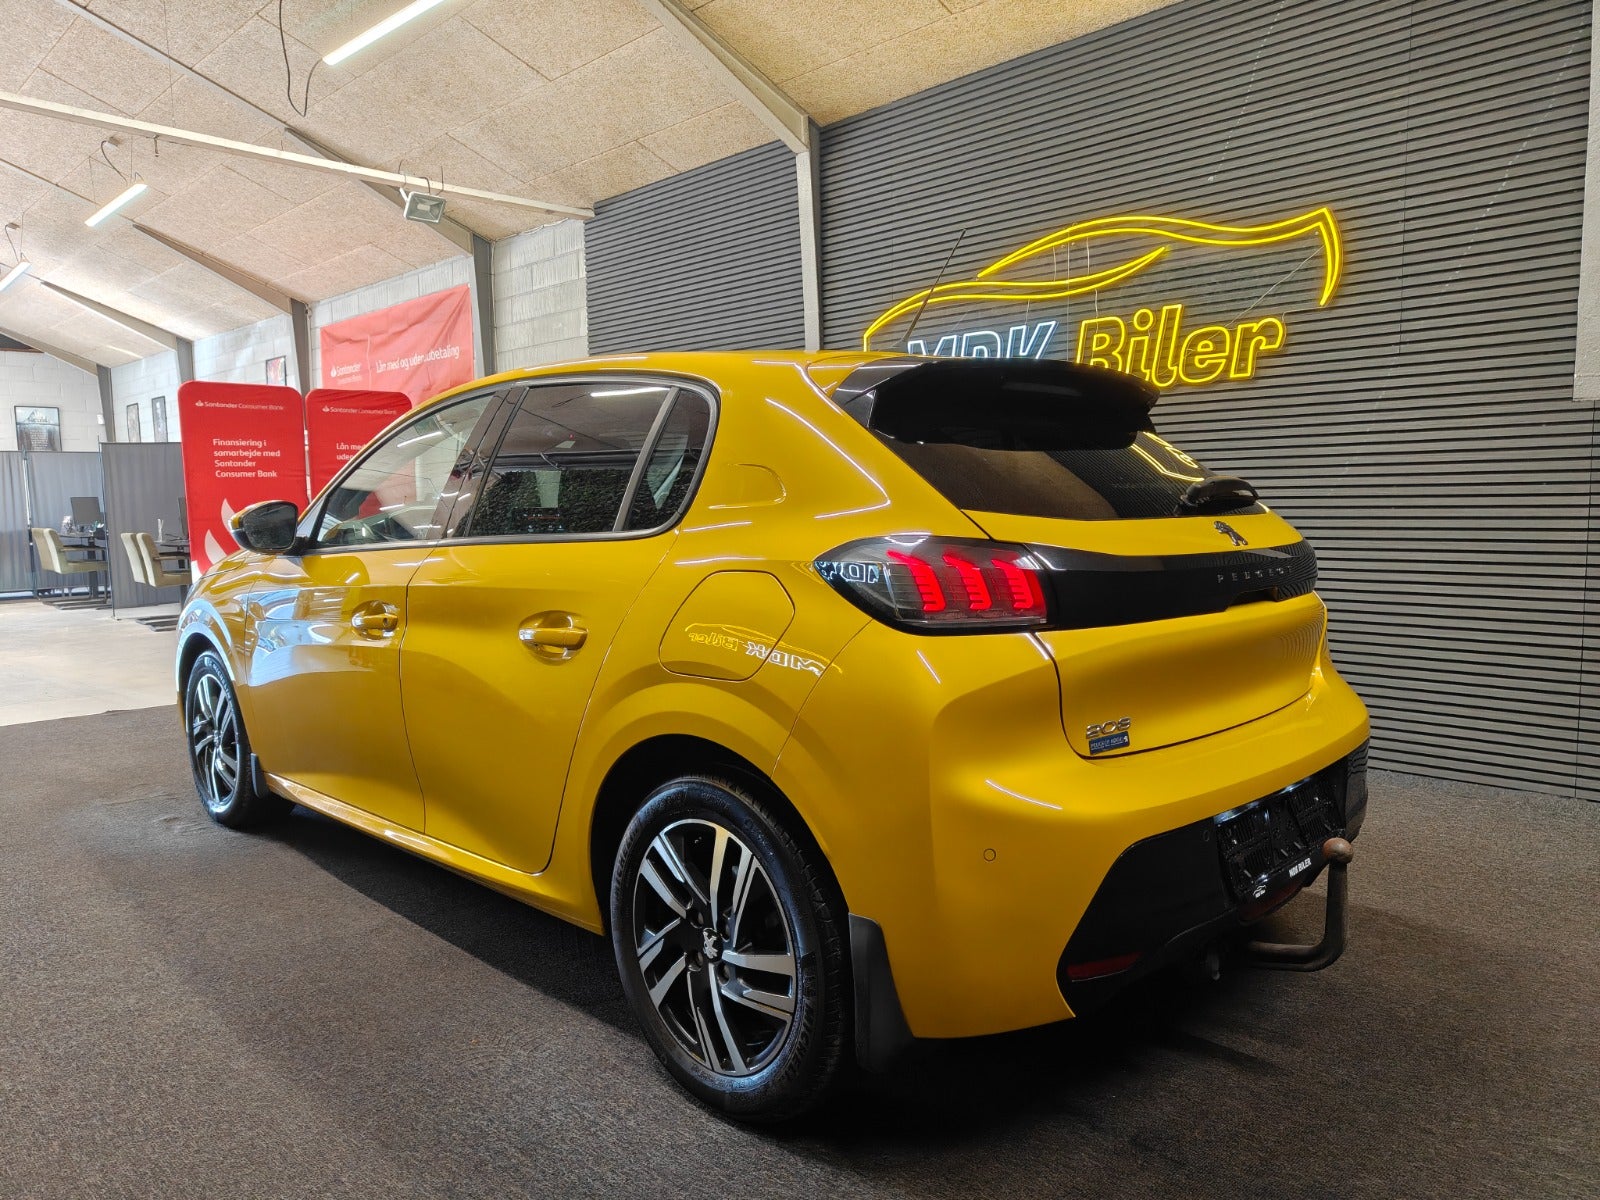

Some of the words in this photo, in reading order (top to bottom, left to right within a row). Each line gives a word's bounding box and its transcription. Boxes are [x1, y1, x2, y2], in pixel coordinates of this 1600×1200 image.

[1076, 304, 1284, 387] Biler
[400, 356, 409, 370] og
[204, 401, 237, 409] Santander
[212, 438, 262, 449] Finansiering
[263, 439, 267, 447] i
[336, 442, 349, 450] Lån
[213, 448, 262, 459] samarbejde
[262, 449, 281, 457] med
[214, 459, 256, 468] Santander
[215, 470, 256, 478] Consumer
[257, 469, 278, 478] Bank
[1086, 717, 1131, 739] 208
